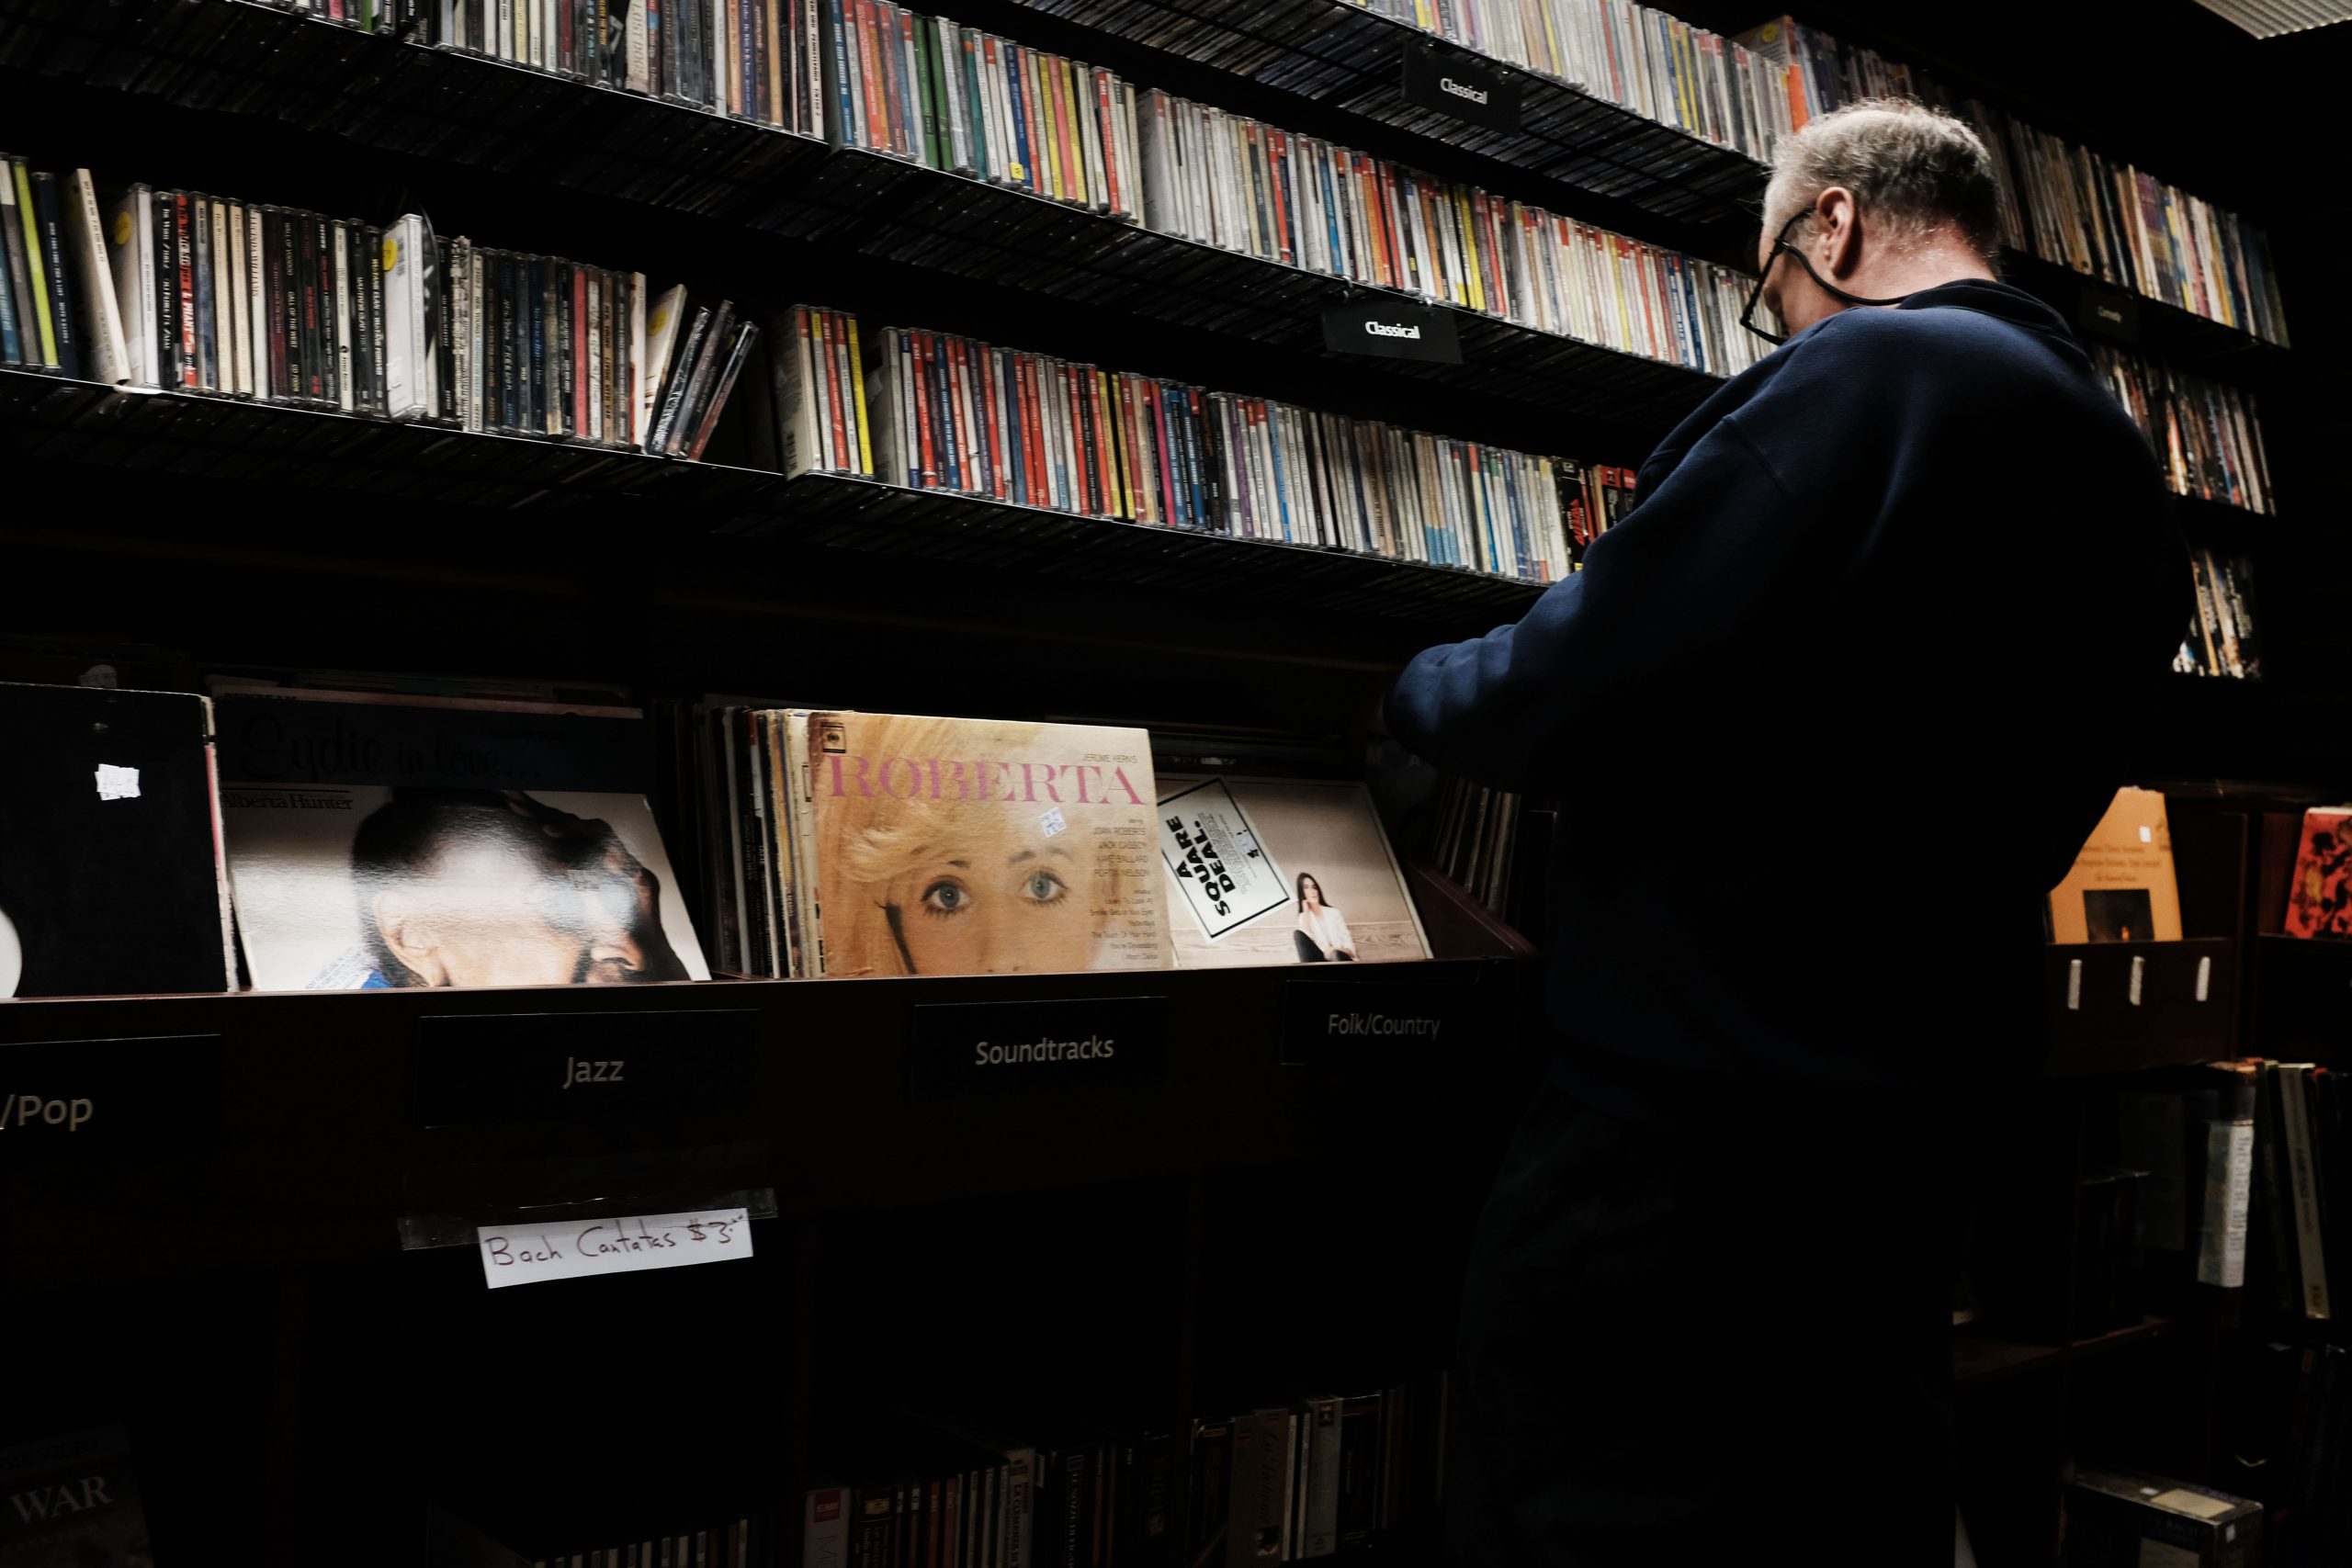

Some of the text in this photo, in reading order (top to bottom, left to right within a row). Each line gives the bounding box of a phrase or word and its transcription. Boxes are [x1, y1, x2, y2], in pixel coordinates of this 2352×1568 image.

[1440, 77, 1488, 105] Classical
[285, 240, 292, 248] OF
[285, 249, 294, 276] VOODOO
[288, 308, 297, 317] OF
[288, 318, 297, 330] THE
[289, 331, 298, 348] WEST
[1364, 321, 1421, 339] Classical
[240, 712, 542, 783] Eydie in love...
[830, 754, 1146, 806] ROBERTA
[220, 792, 353, 811] Alberta Hunter
[1165, 815, 1231, 916] SQUARE
[1176, 861, 1193, 878] A
[1194, 820, 1236, 893] DEAL.
[1327, 1012, 1441, 1041] Folk/Country
[973, 1034, 1115, 1066] Soundtracks
[562, 1055, 625, 1090] Jazz
[484, 1217, 677, 1268] Bach Cantatas
[8, 1473, 114, 1525] WAR
